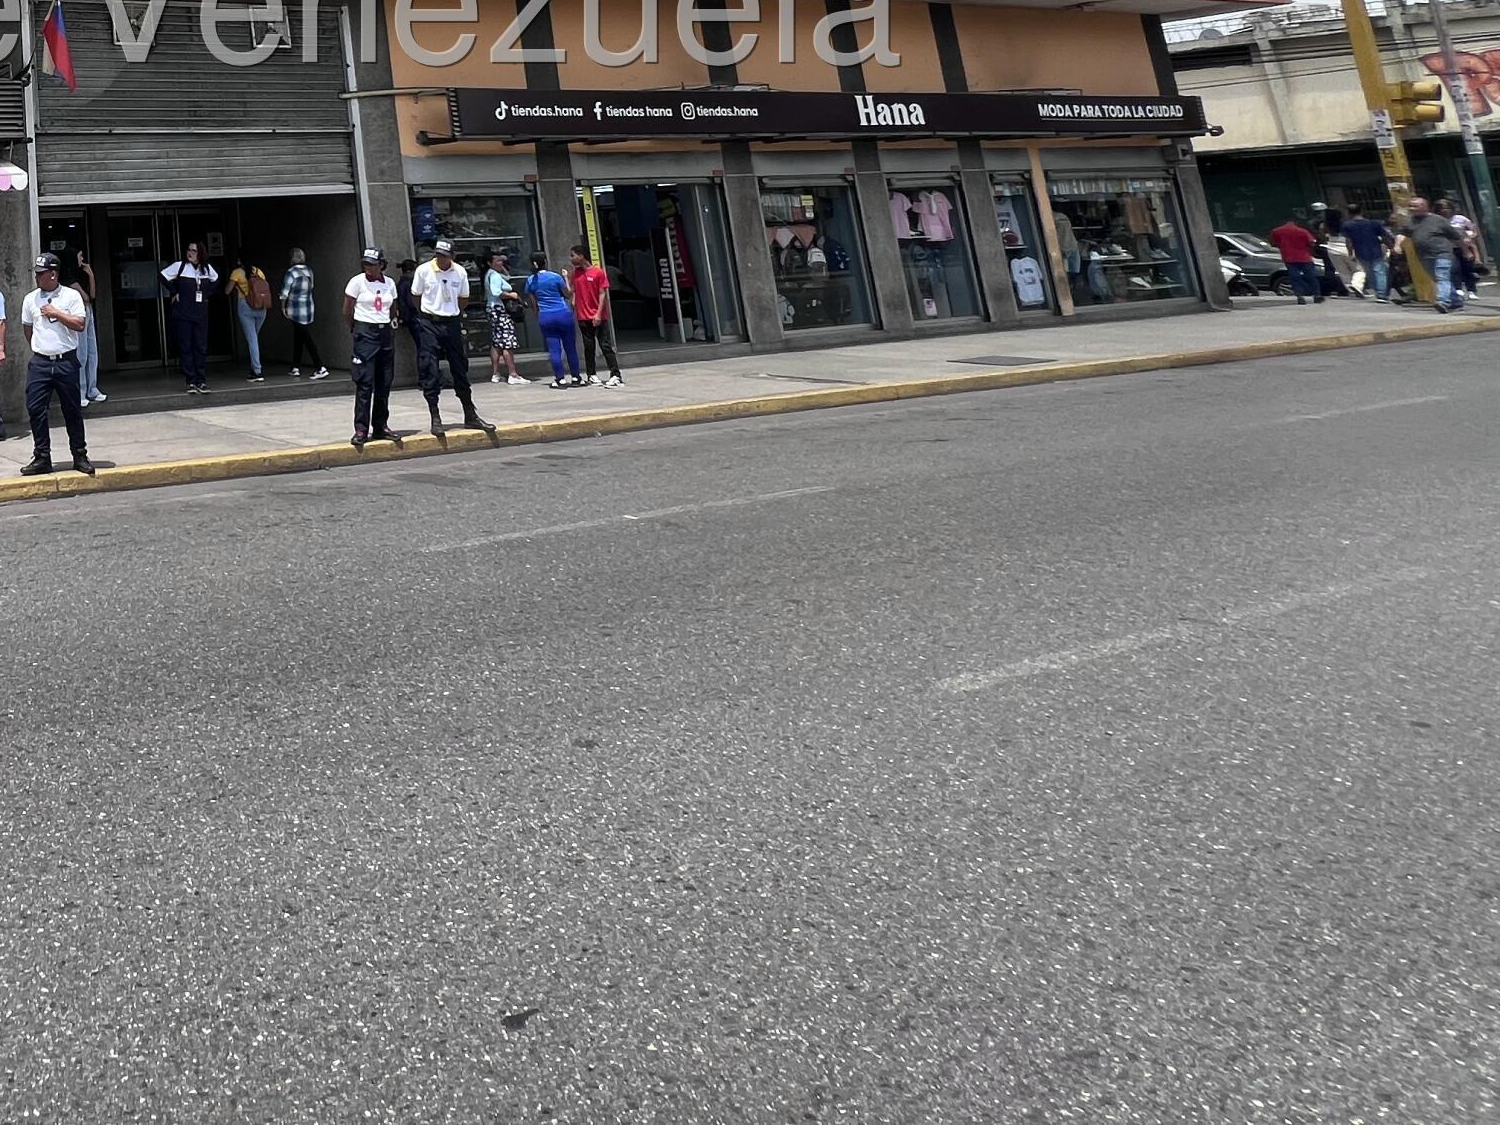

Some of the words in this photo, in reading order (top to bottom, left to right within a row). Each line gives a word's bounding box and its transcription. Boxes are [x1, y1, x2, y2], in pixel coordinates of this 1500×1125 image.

[511, 104, 584, 117] tiendas.hana
[696, 105, 759, 117] tiendas.hana
[854, 94, 926, 126] Hana
[1038, 103, 1073, 117] MODA
[1074, 105, 1100, 117] PARA
[1102, 105, 1133, 118] TODA
[1133, 106, 1145, 118] LA
[1146, 105, 1184, 118] CIUDAD
[659, 258, 674, 299] Hana
